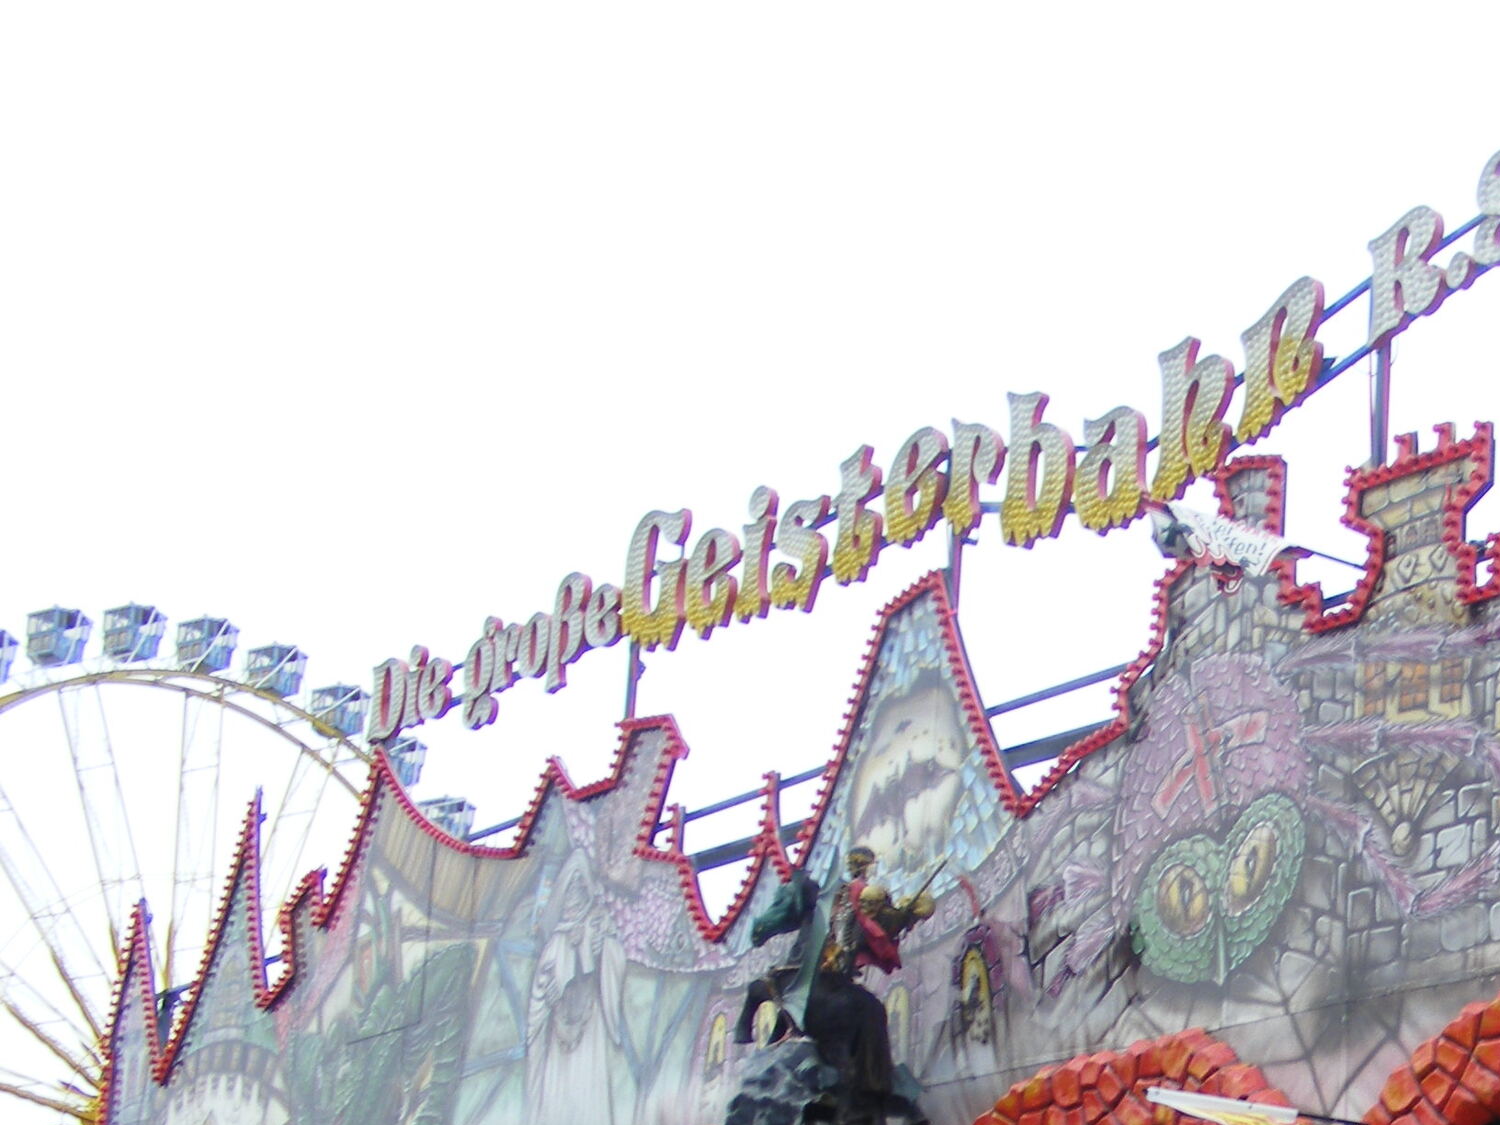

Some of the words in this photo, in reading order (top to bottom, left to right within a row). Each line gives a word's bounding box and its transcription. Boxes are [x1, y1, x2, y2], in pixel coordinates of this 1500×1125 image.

[368, 645, 453, 743] Die
[463, 572, 624, 731] große
[622, 276, 1325, 652] Geisterbahn
